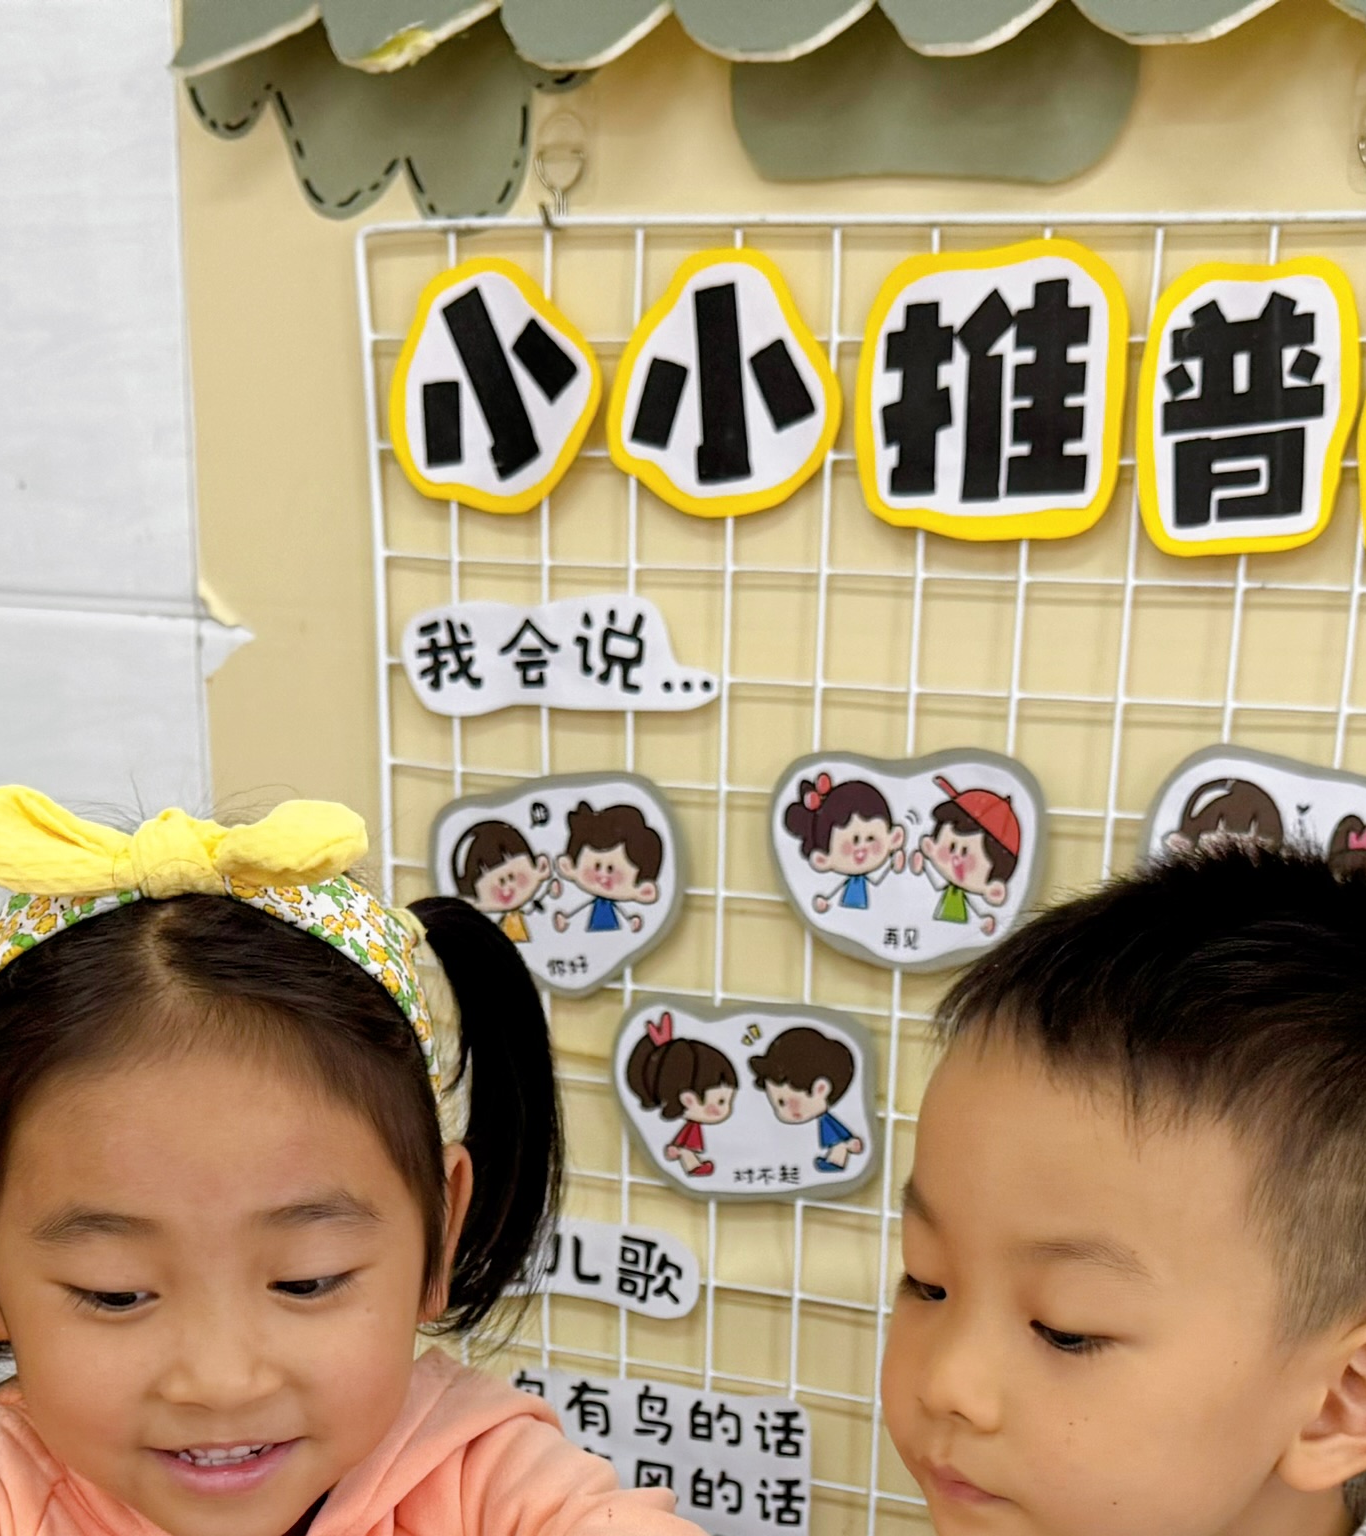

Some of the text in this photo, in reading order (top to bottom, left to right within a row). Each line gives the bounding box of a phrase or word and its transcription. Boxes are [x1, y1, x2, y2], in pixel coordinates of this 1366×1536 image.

[883, 927, 919, 950] 再见
[733, 1164, 802, 1185] 对不起
[546, 1233, 683, 1305] 儿歌
[582, 1448, 806, 1526] 风的话
